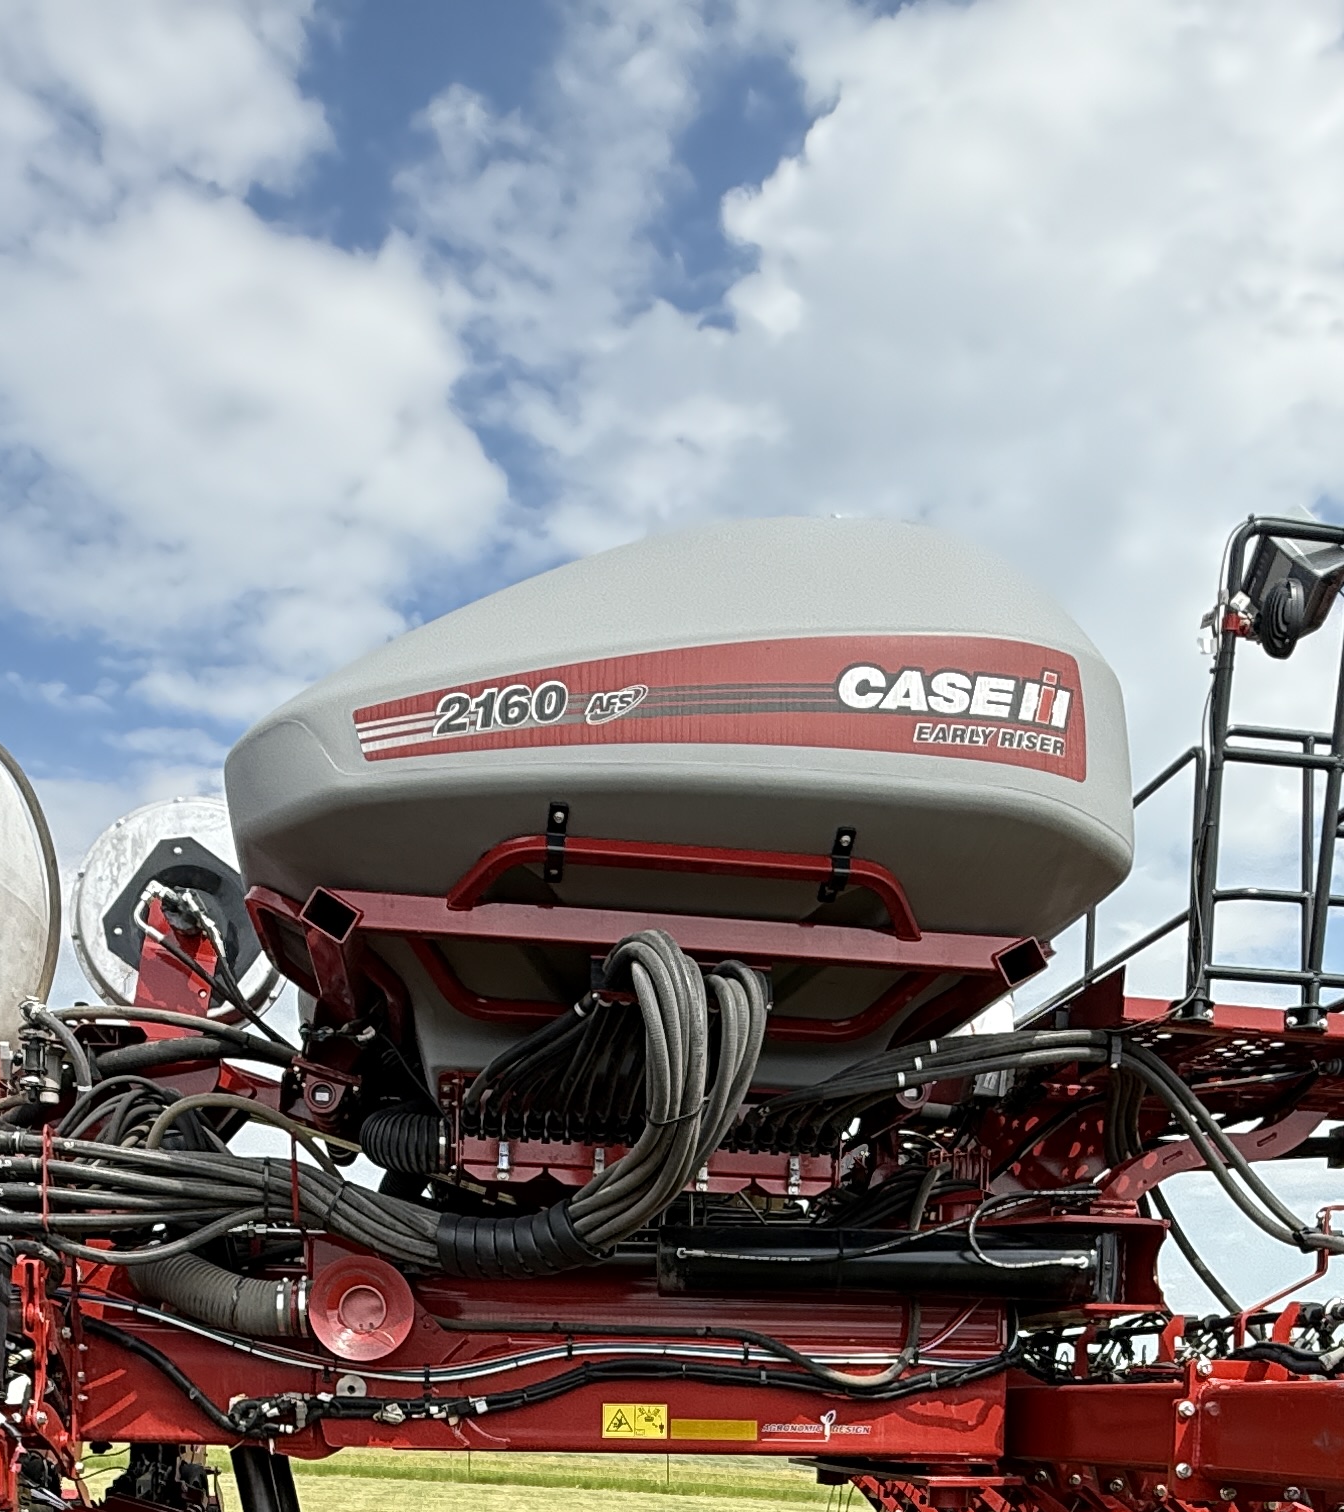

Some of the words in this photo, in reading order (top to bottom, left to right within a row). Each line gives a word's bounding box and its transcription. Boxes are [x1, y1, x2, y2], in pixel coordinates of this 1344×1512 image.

[432, 681, 568, 737] 2160
[585, 690, 636, 717] AFS
[913, 722, 997, 747] EARLY
[997, 726, 1066, 758] RISER
[760, 1423, 823, 1434] AGRONOMIC
[830, 1424, 872, 1435] DESIGN
